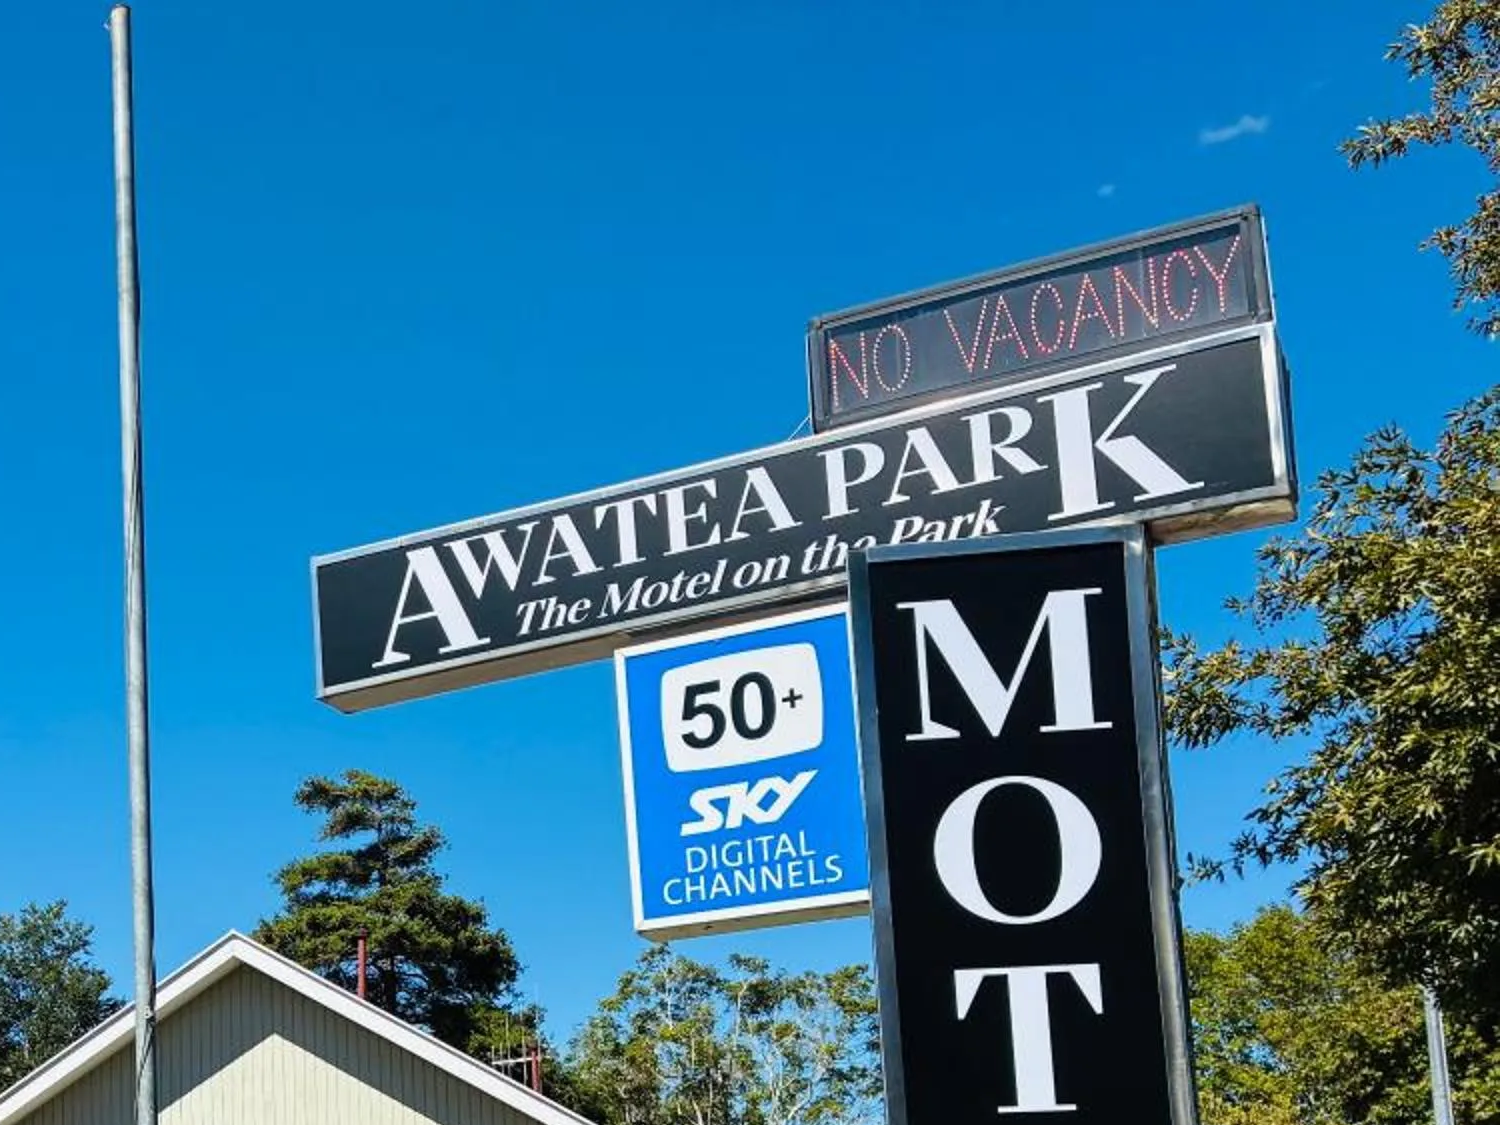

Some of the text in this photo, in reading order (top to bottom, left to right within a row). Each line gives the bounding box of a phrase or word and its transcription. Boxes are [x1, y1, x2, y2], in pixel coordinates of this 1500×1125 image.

[829, 234, 1242, 407] NO VACANCY
[371, 363, 1205, 669] AWATEA PARK
[515, 594, 591, 637] The
[598, 557, 730, 620] Motel
[732, 551, 790, 590] on
[888, 498, 1007, 545] Park
[681, 671, 804, 750] 50+
[680, 768, 819, 837] SKY
[662, 854, 844, 906] CHANNELS
[685, 830, 817, 874] DIGITAL
